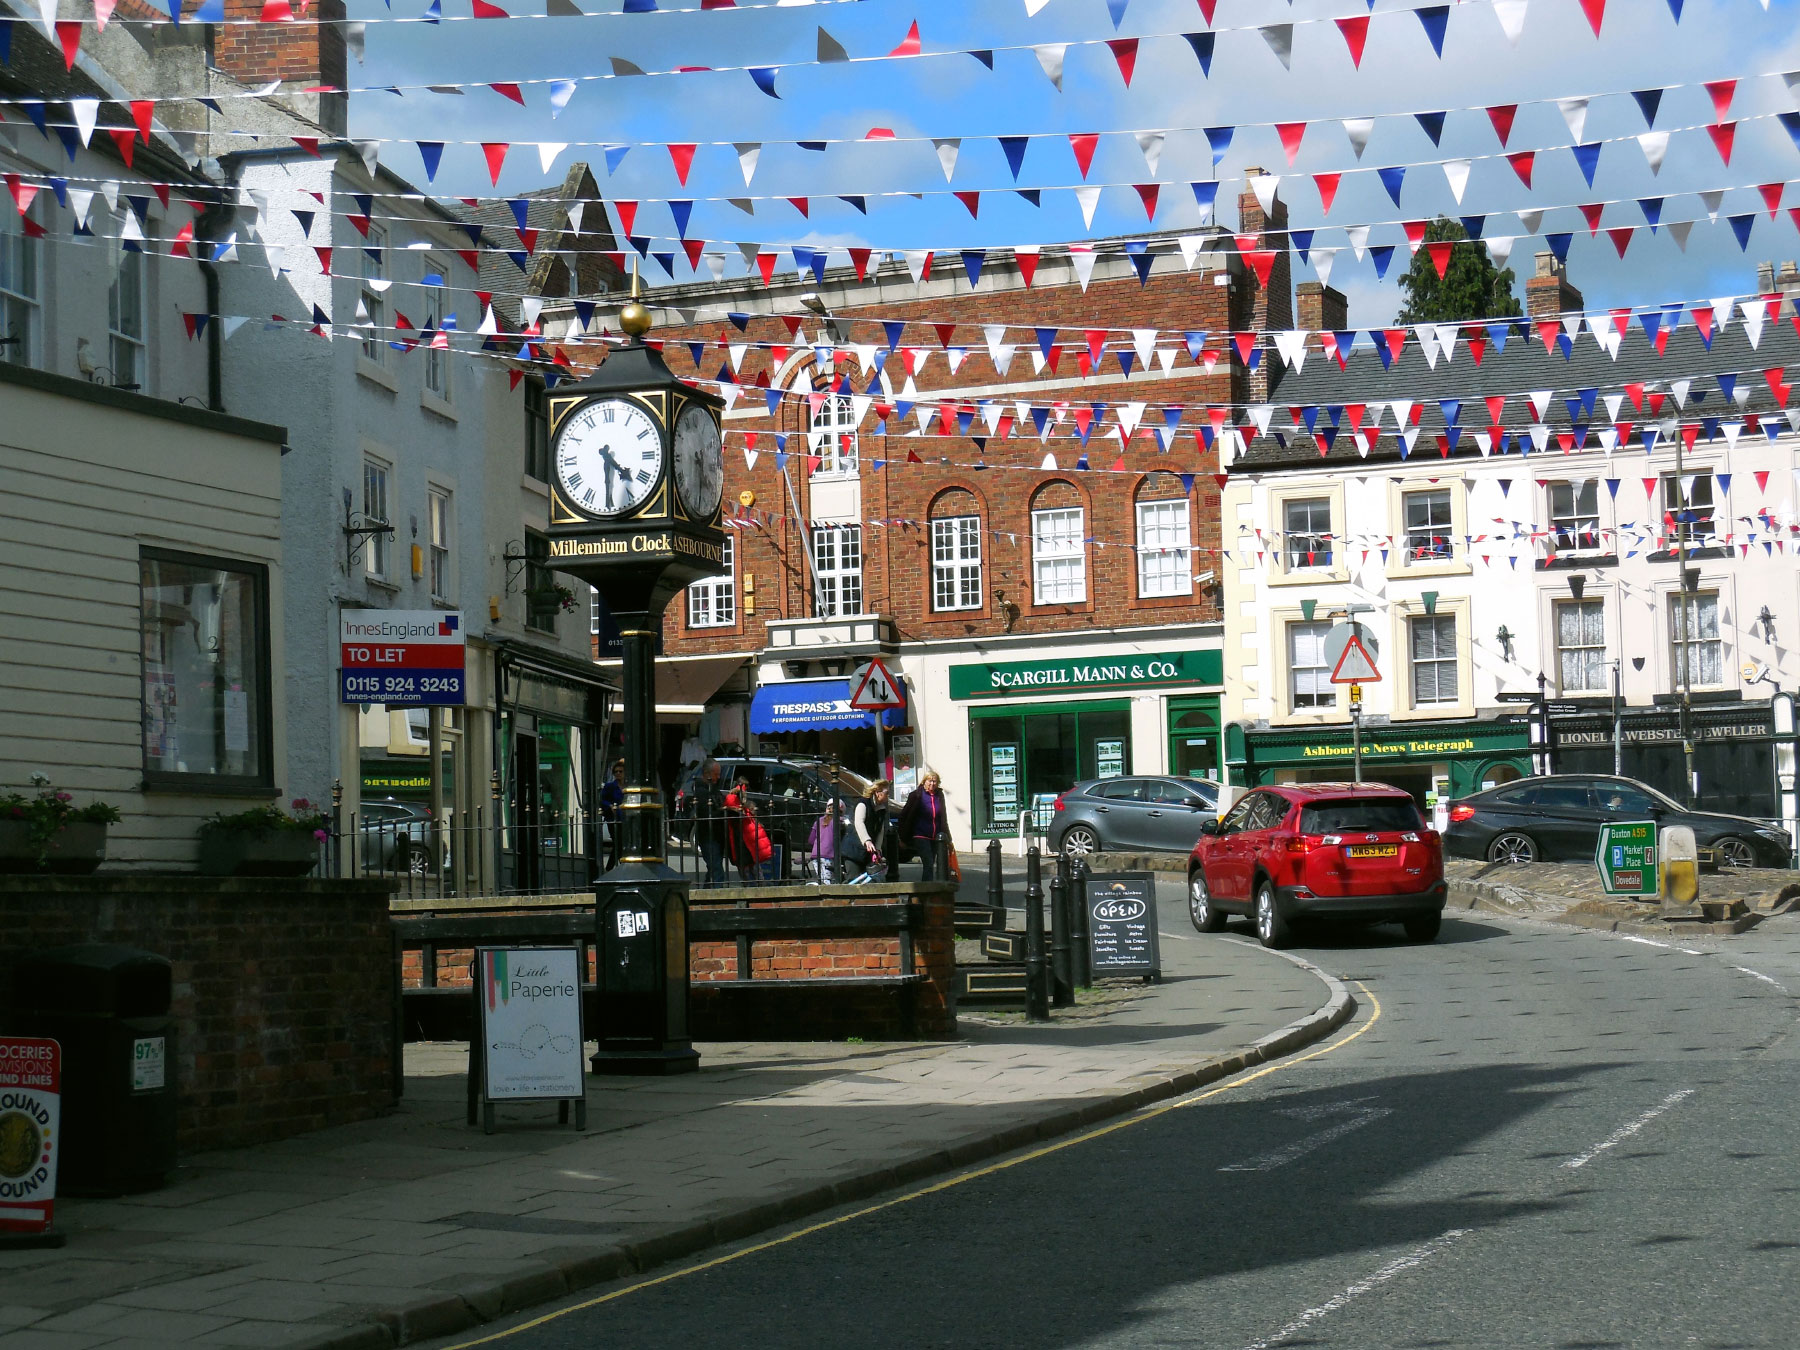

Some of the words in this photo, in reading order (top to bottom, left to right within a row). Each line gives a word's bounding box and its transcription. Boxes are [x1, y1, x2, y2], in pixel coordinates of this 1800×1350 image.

[549, 538, 628, 557] Millennium
[631, 533, 672, 552] Clock
[673, 536, 723, 563] ASHBOURNE
[345, 621, 435, 640] InnesEngland
[347, 647, 371, 662] TO
[375, 648, 406, 662] LET
[991, 669, 1069, 688] SCARGILL
[1073, 665, 1127, 683] MANN
[1131, 665, 1145, 679] &
[346, 677, 380, 692] 0115
[384, 677, 415, 692] 924
[420, 677, 460, 692] 3243
[346, 692, 421, 702] innes-england.com
[772, 702, 832, 715] TRESPASS
[771, 716, 811, 724] PERFORMANCE
[812, 714, 837, 722] OUTDOOR
[838, 713, 865, 721] CLOTHING
[1559, 731, 1608, 744] LIONEL
[1625, 728, 1687, 741] WEBSTE
[1373, 743, 1406, 754] News
[1408, 739, 1474, 753] Telegraph
[1611, 828, 1631, 839] Buxton
[1632, 827, 1647, 838] A515
[1623, 845, 1643, 855] Market
[1625, 857, 1642, 867] Place
[1615, 875, 1641, 885] Dovedale
[1100, 903, 1138, 918] OPEN
[513, 964, 550, 978] Little
[511, 980, 575, 1002] Paperie
[22, 1074, 53, 1086] LINES
[493, 1085, 511, 1093] love
[538, 1082, 575, 1093] stationery
[0, 1093, 50, 1126] OUND
